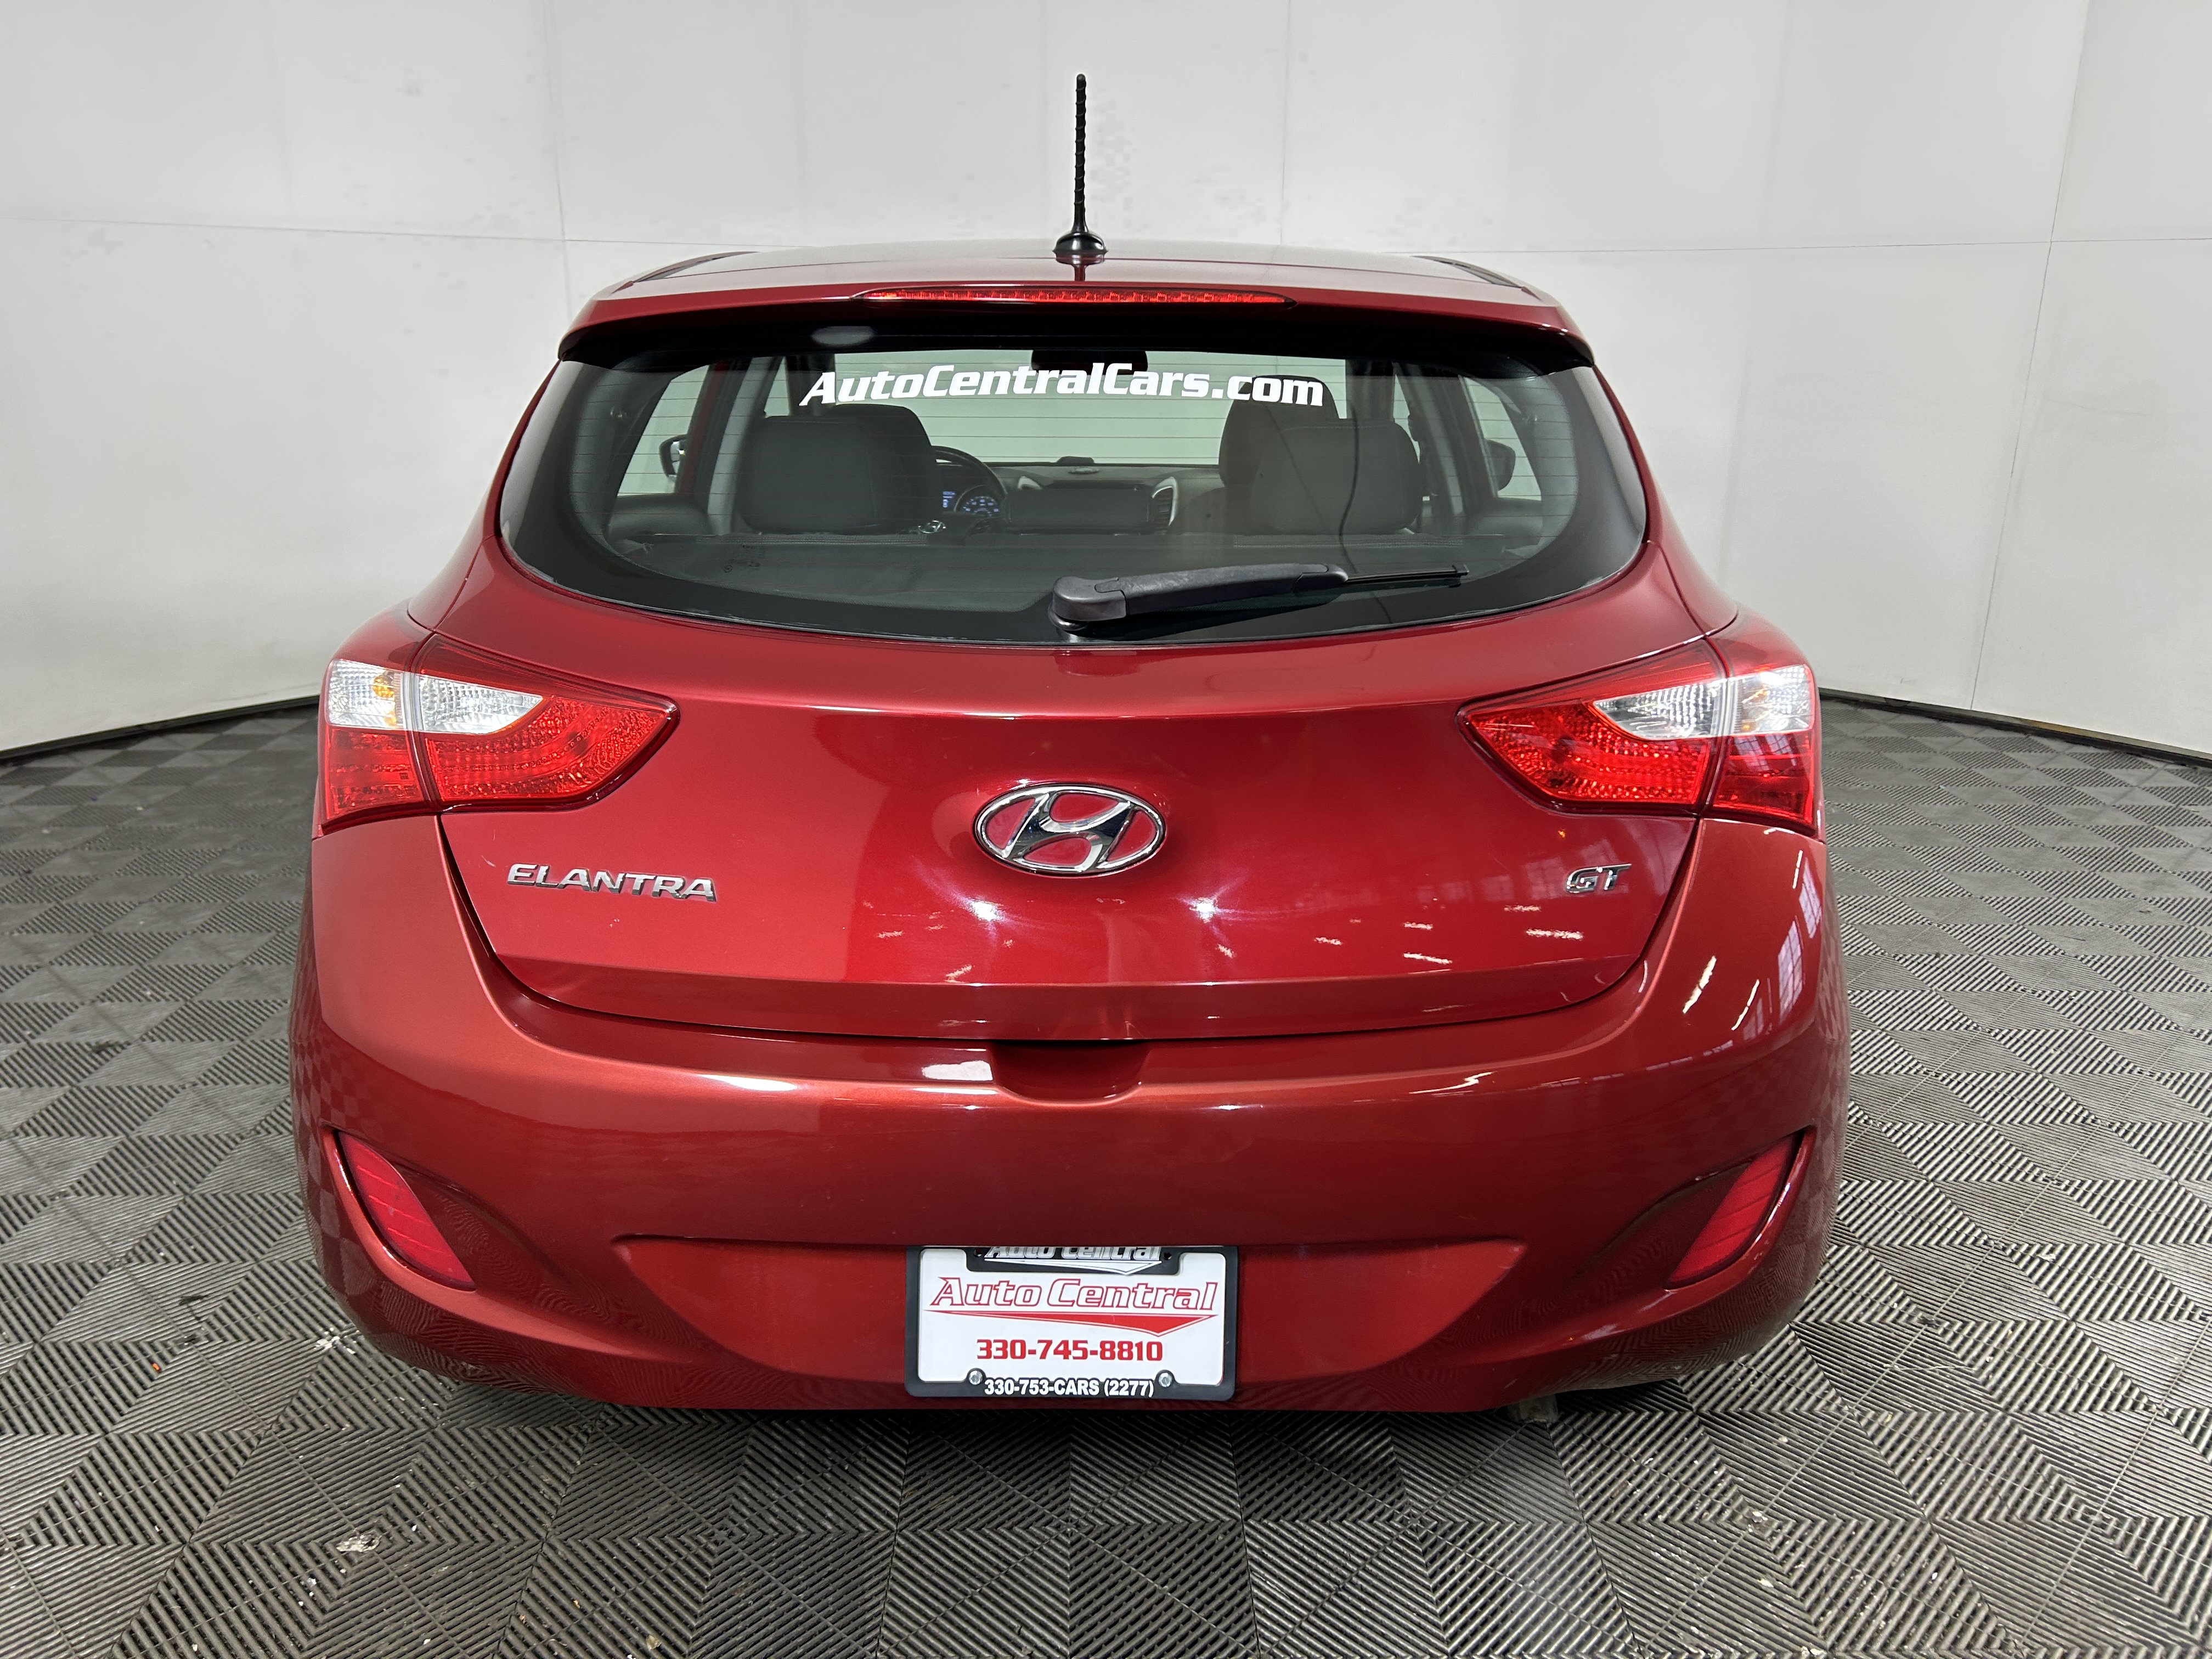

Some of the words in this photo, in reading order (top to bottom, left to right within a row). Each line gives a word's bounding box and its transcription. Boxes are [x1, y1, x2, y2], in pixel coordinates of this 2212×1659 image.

[799, 362, 1323, 407] AutoCentralCars.com
[507, 863, 717, 902] ELANTRA
[1566, 863, 1632, 894] GT
[929, 1277, 1043, 1307] Auto
[1046, 1278, 1218, 1311] Central
[977, 1339, 1164, 1362] 330-745-8810
[984, 1378, 1100, 1396] 330-753-CARS
[1103, 1379, 1154, 1398] (2277)
